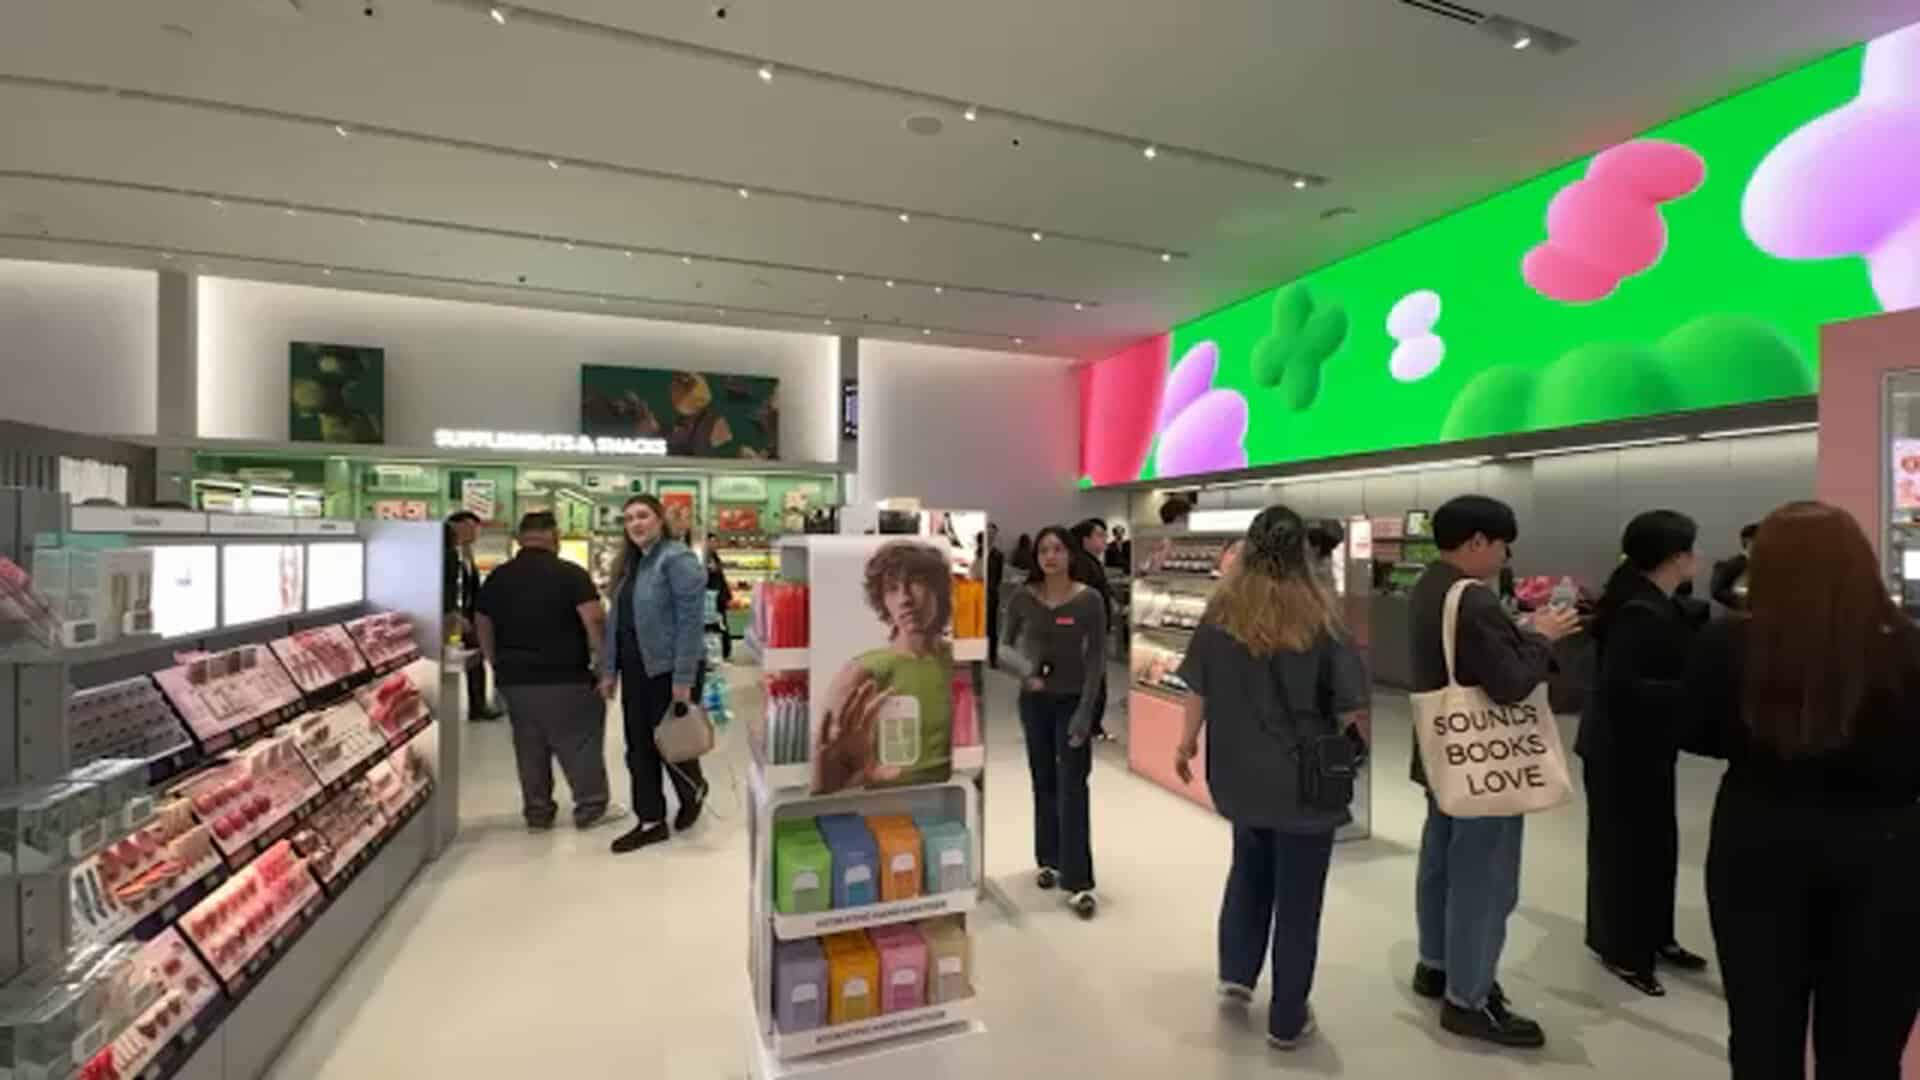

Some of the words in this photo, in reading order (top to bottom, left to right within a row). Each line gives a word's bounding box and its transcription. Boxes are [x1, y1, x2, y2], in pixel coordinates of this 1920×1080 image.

[434, 429, 575, 451] SUPPLEMENTS
[1446, 734, 1547, 766] BOOKS
[1466, 765, 1545, 796] LOVE
